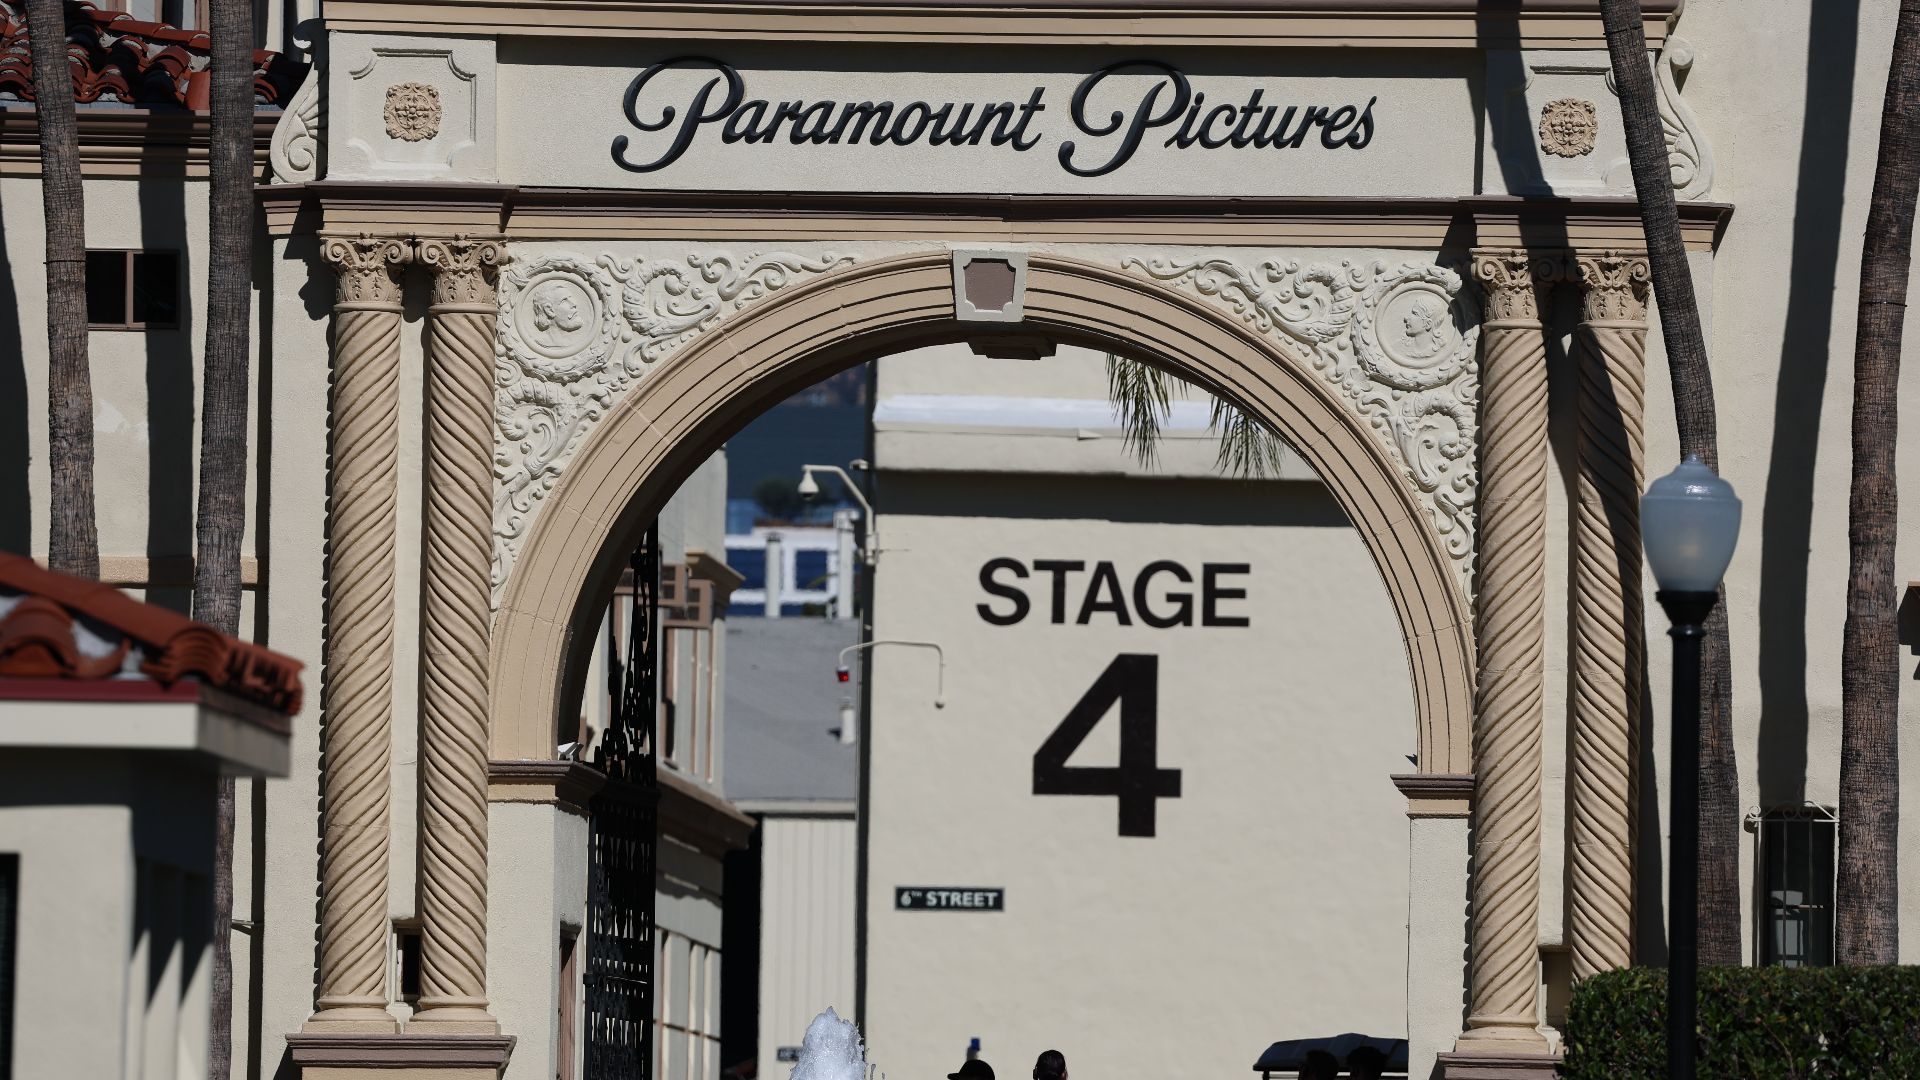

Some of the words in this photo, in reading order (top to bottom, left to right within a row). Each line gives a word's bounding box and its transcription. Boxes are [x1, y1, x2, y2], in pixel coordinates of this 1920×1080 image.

[611, 56, 1045, 172] Paramount
[1058, 60, 1377, 177] Pictures
[976, 557, 1251, 629] STAGE
[1032, 653, 1182, 838] 4
[926, 890, 998, 907] STREET
